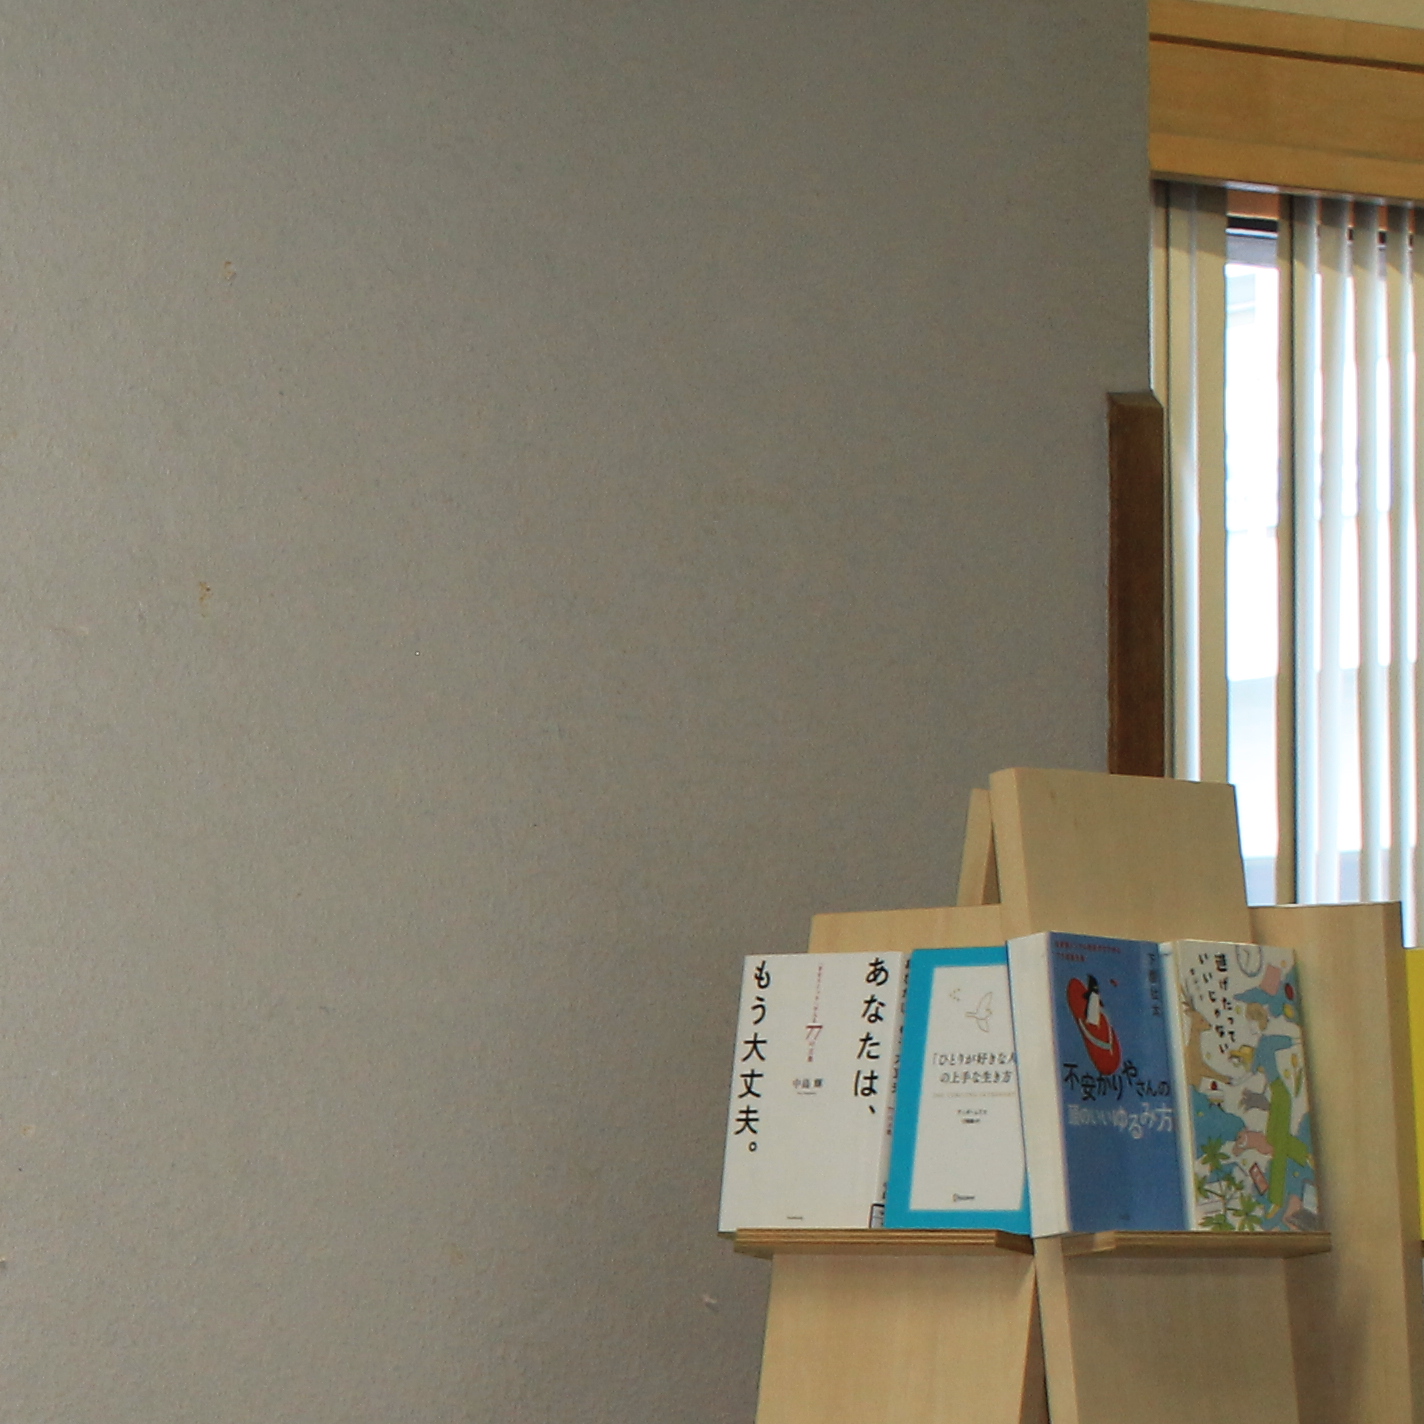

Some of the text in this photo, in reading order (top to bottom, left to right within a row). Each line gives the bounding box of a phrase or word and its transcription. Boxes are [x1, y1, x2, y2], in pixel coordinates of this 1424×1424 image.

[733, 960, 772, 1153] もう大丈夫。
[853, 957, 890, 1115] あなたは、
